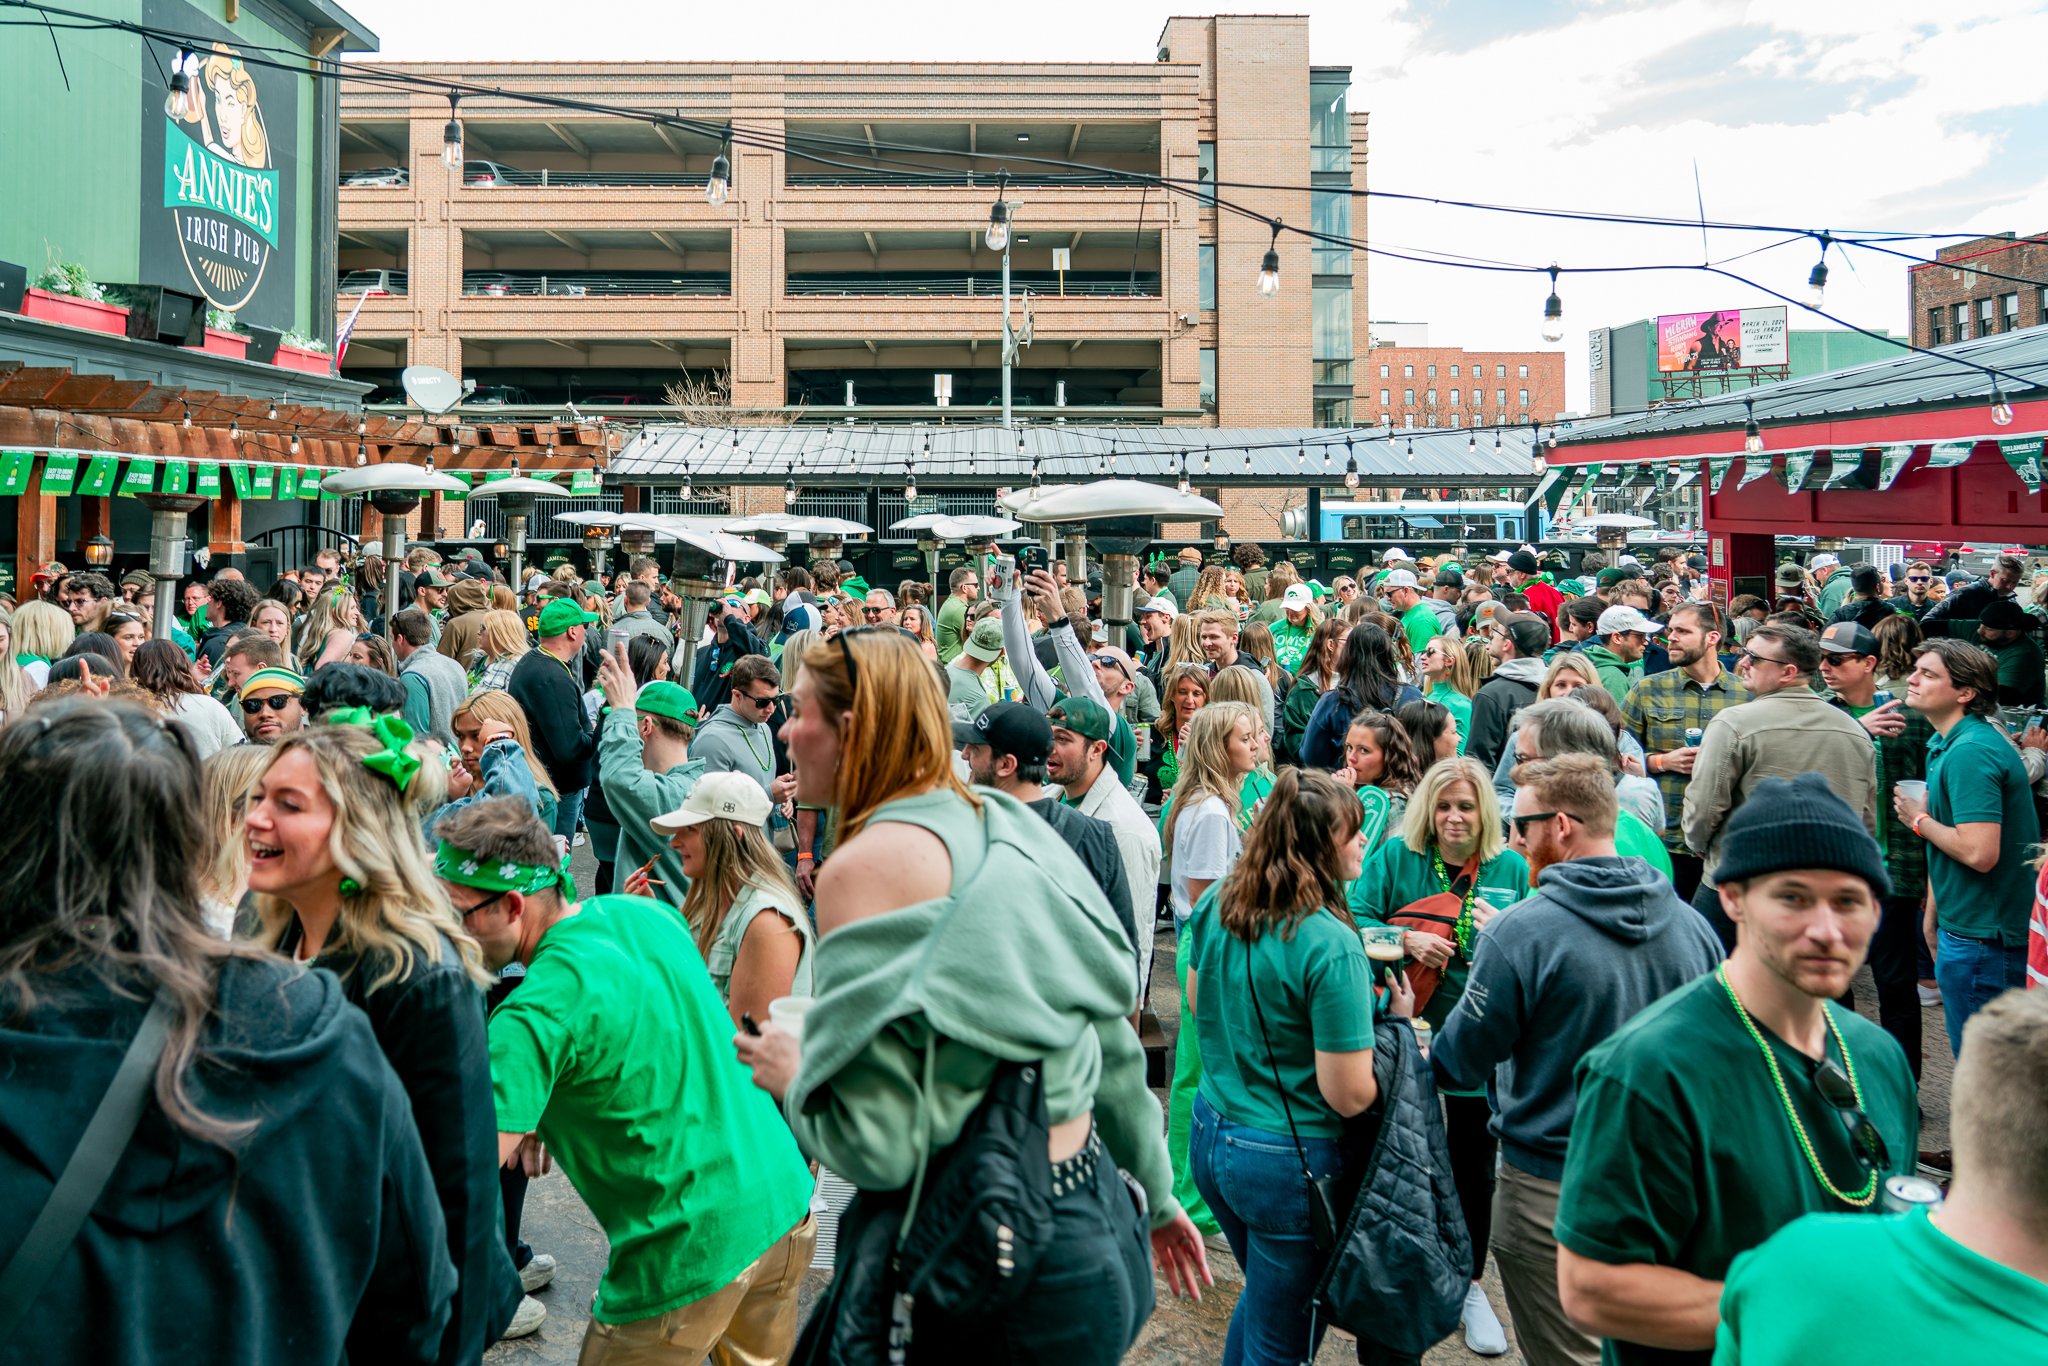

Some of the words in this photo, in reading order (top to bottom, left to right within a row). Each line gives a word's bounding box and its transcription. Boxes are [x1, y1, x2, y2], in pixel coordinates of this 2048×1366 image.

[173, 142, 273, 234] ANNIE'S
[186, 215, 230, 254] IRISH
[233, 231, 260, 266] PUB
[896, 555, 918, 563] JAMESON
[1331, 555, 1354, 563] JAMESON
